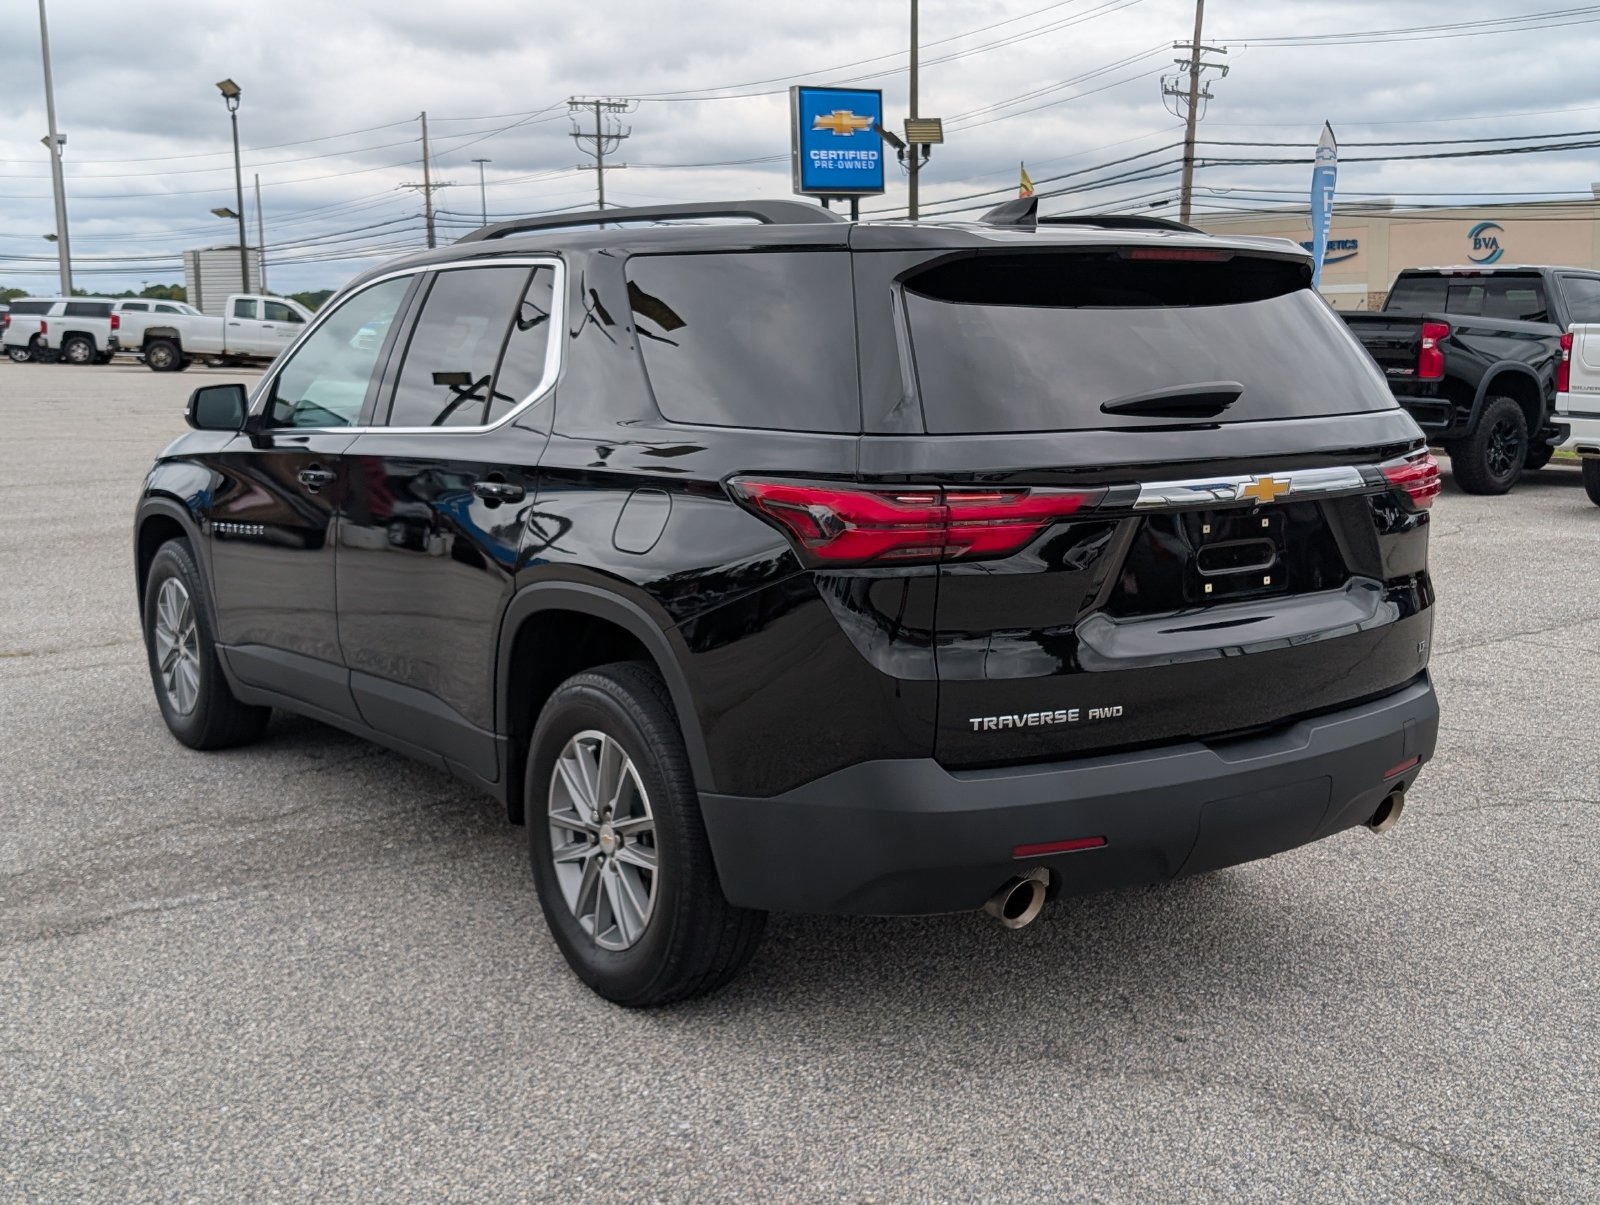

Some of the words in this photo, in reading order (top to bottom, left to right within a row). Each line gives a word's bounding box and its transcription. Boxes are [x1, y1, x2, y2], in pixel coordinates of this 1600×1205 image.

[810, 150, 878, 160] CERTIFIED
[814, 161, 875, 169] PRE-OWNED
[1472, 236, 1500, 251] BVA
[969, 708, 1080, 731] TRAVERSE
[1088, 705, 1124, 720] AWD
